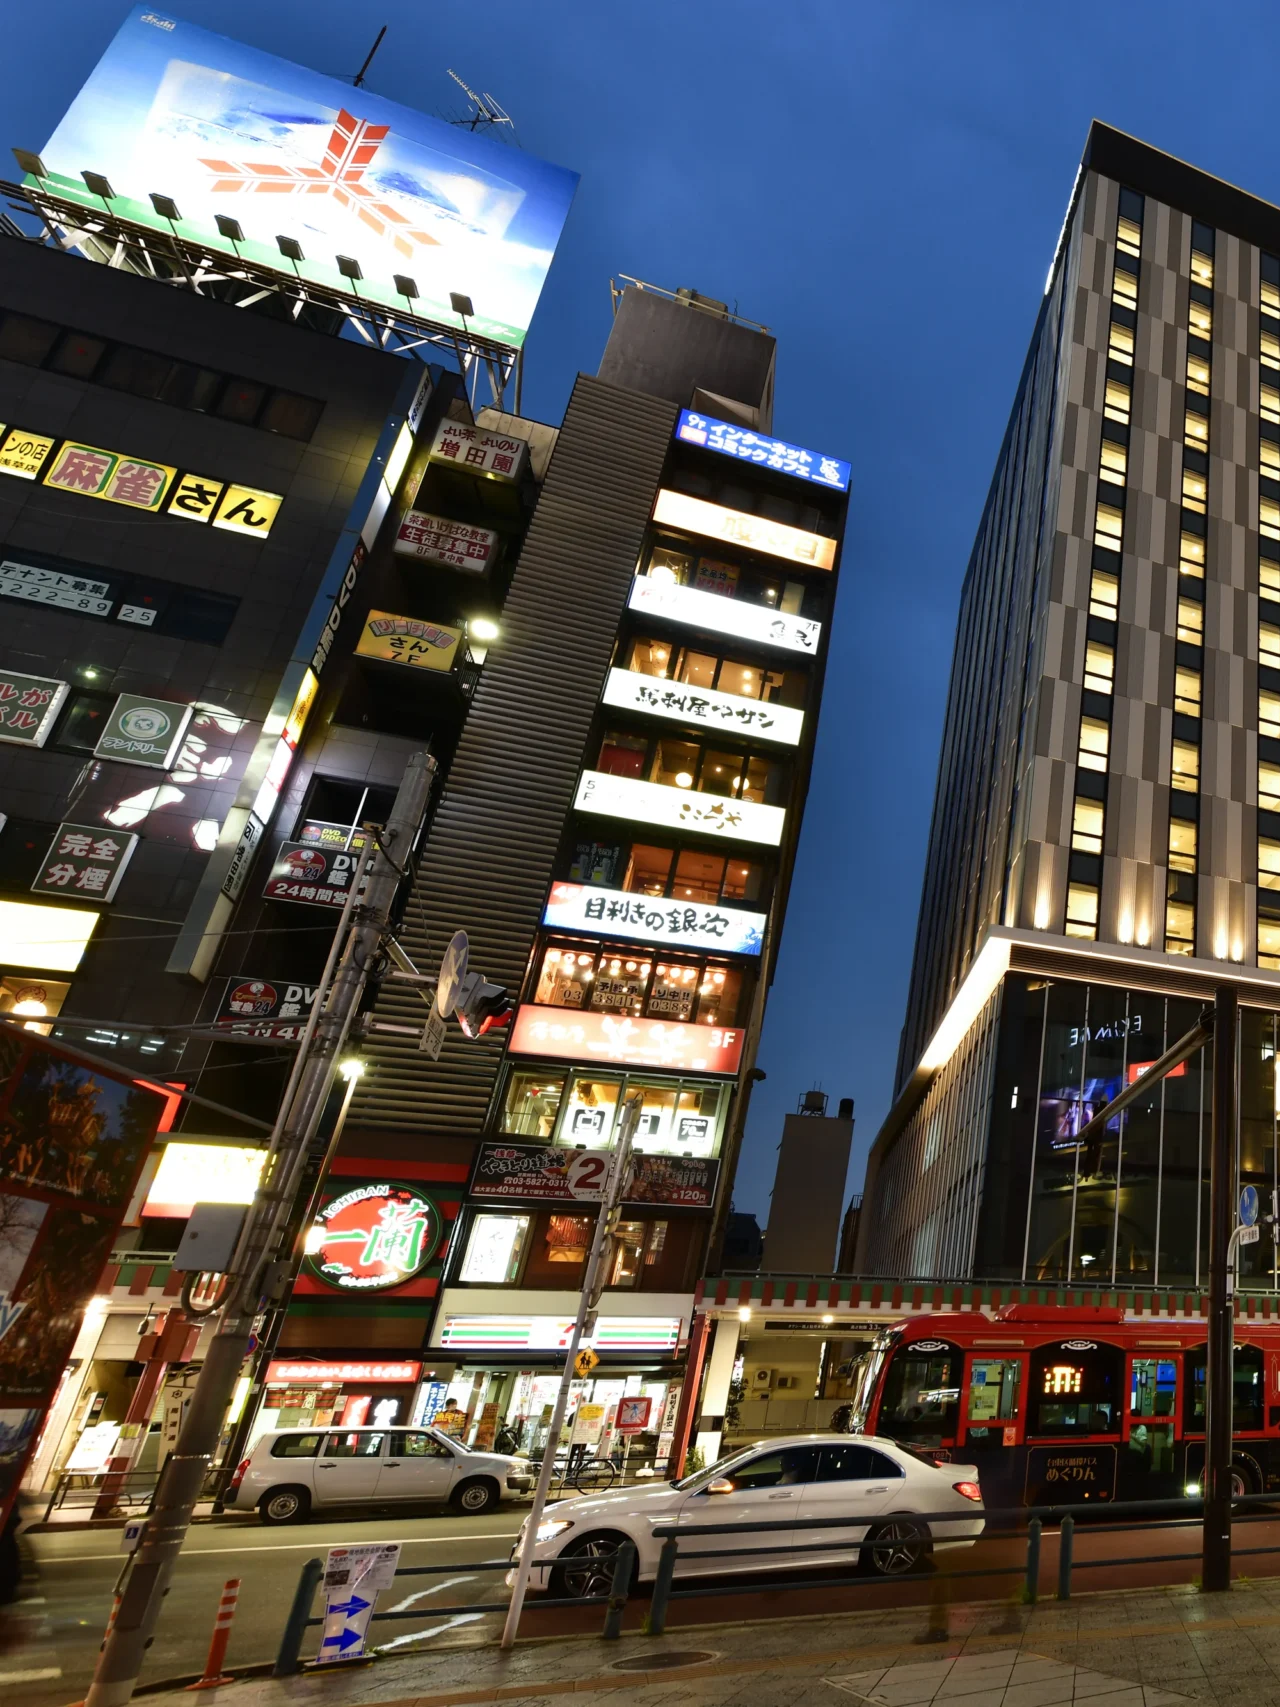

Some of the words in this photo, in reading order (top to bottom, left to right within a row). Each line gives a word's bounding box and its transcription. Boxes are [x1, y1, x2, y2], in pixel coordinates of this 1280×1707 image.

[437, 438, 515, 474] 増田園
[708, 434, 810, 477] コミックカフェ
[711, 425, 812, 463] インターネット
[404, 527, 486, 558] 生徒募集中
[1, 564, 105, 596] テナント募集
[390, 637, 429, 654] さん
[103, 736, 167, 756] ランドリー
[58, 833, 121, 862] 完全
[44, 863, 111, 891] 分煙
[584, 897, 730, 937] 目利きの銀次
[707, 1030, 736, 1048] 3F
[323, 1184, 390, 1219] ICHIRAN
[324, 1198, 429, 1273] 一蘭
[1046, 1467, 1096, 1481] めぐりん
